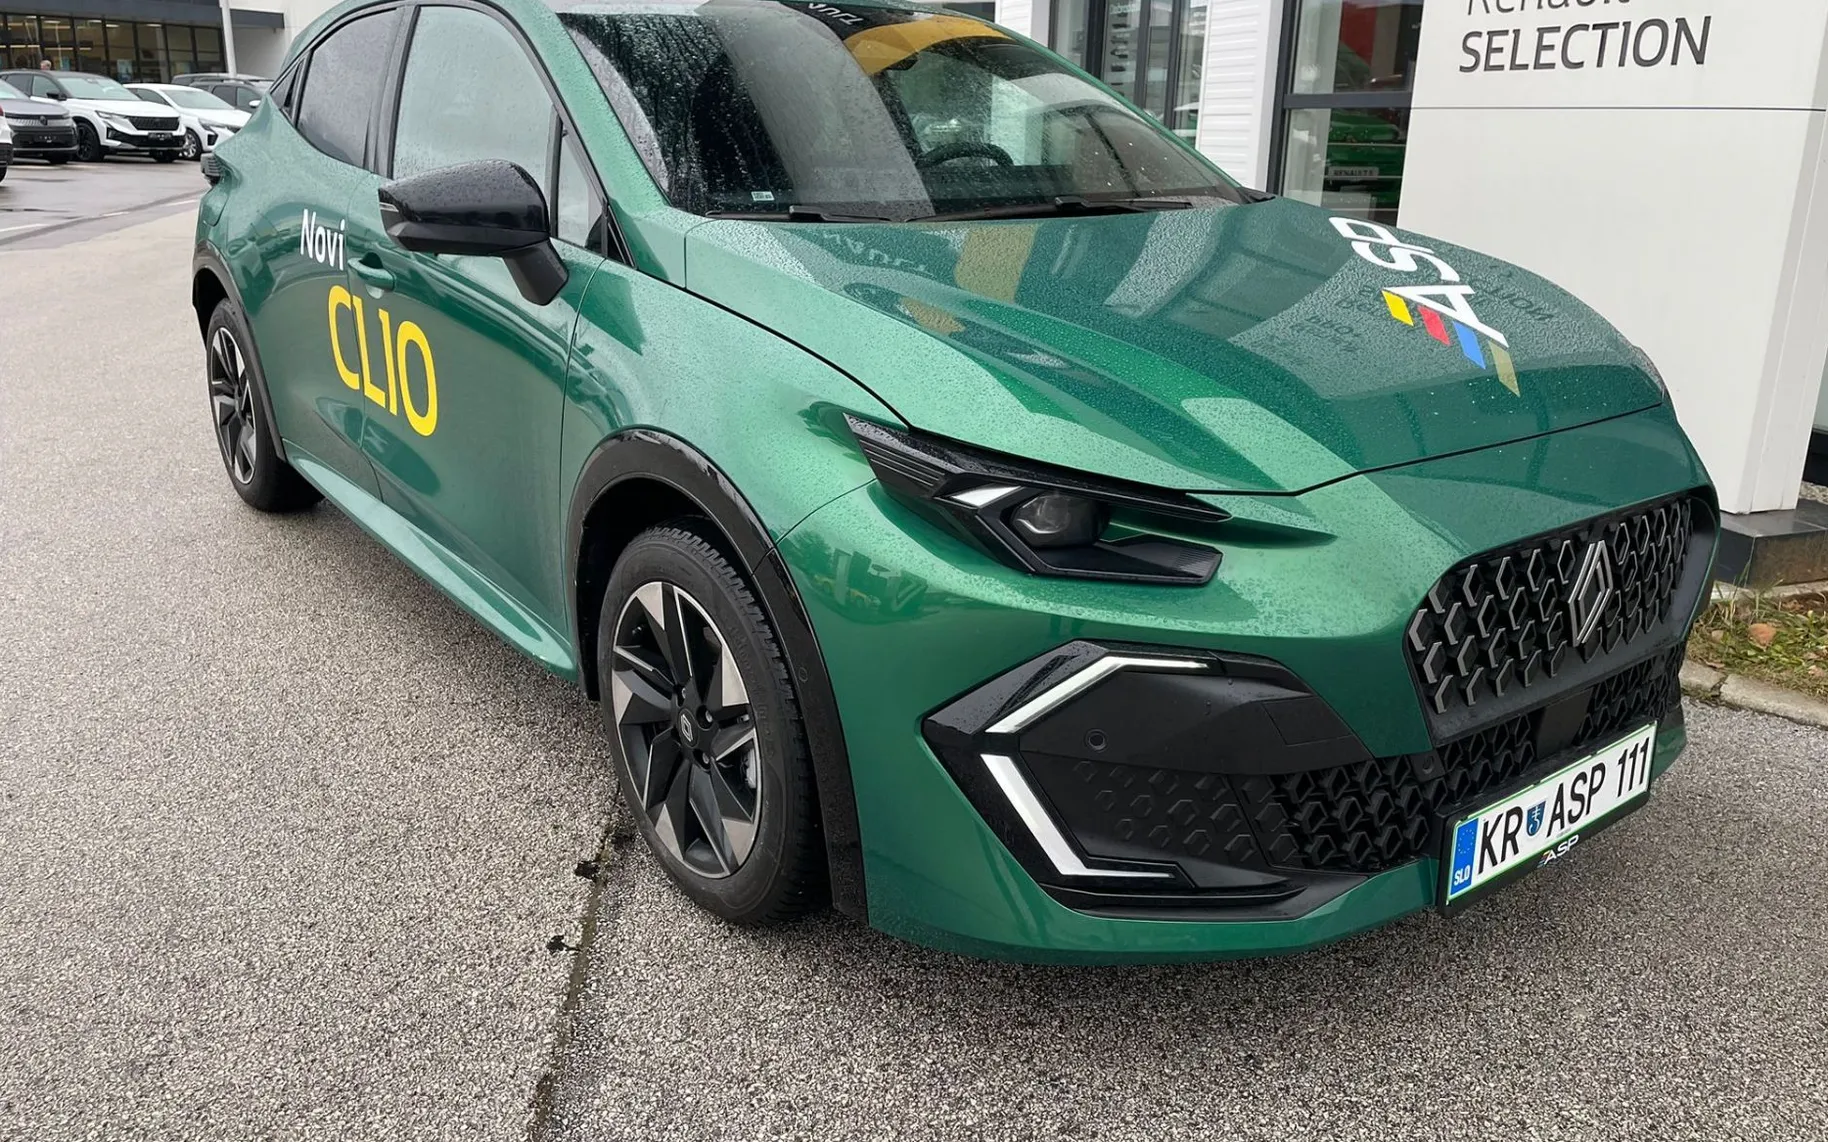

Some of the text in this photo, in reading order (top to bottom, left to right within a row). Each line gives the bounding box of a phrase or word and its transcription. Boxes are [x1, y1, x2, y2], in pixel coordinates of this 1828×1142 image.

[1459, 16, 1711, 72] SELECTION
[301, 209, 345, 271] Novi
[1328, 216, 1509, 348] ASP
[328, 285, 438, 437] CLIO
[1478, 736, 1650, 875] KR ASP 111
[1453, 864, 1470, 887] SLO
[1543, 834, 1579, 865] ASP
